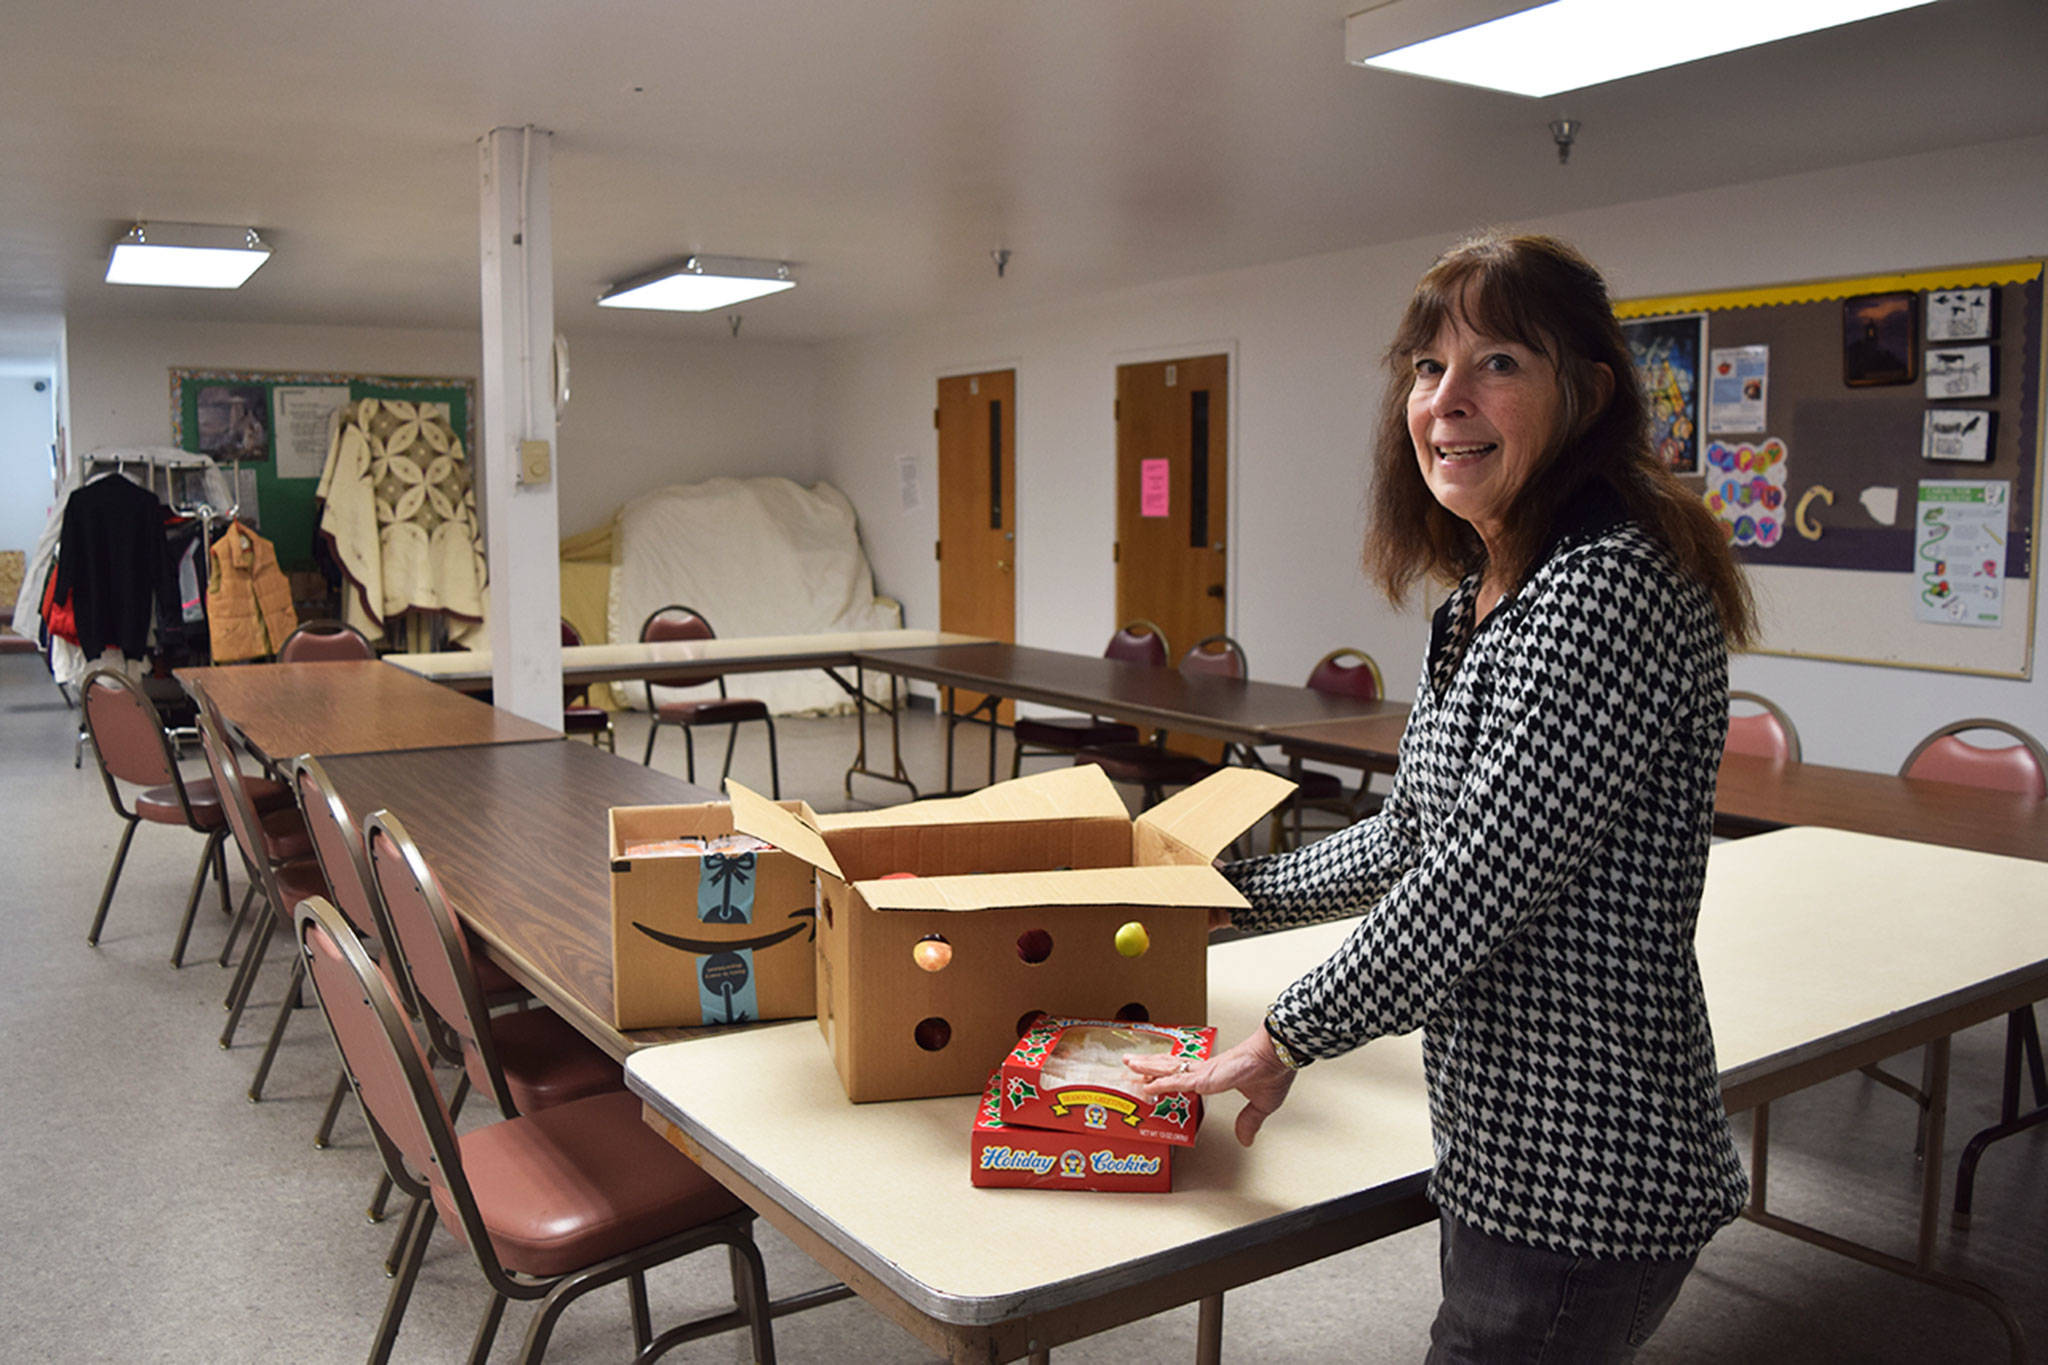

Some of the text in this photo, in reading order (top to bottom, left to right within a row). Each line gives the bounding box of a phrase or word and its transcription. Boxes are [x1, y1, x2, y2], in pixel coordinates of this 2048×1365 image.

[1709, 445, 1781, 471] HAPPY
[981, 1147, 1056, 1174] Holiday
[1090, 1150, 1160, 1174] Cookies
